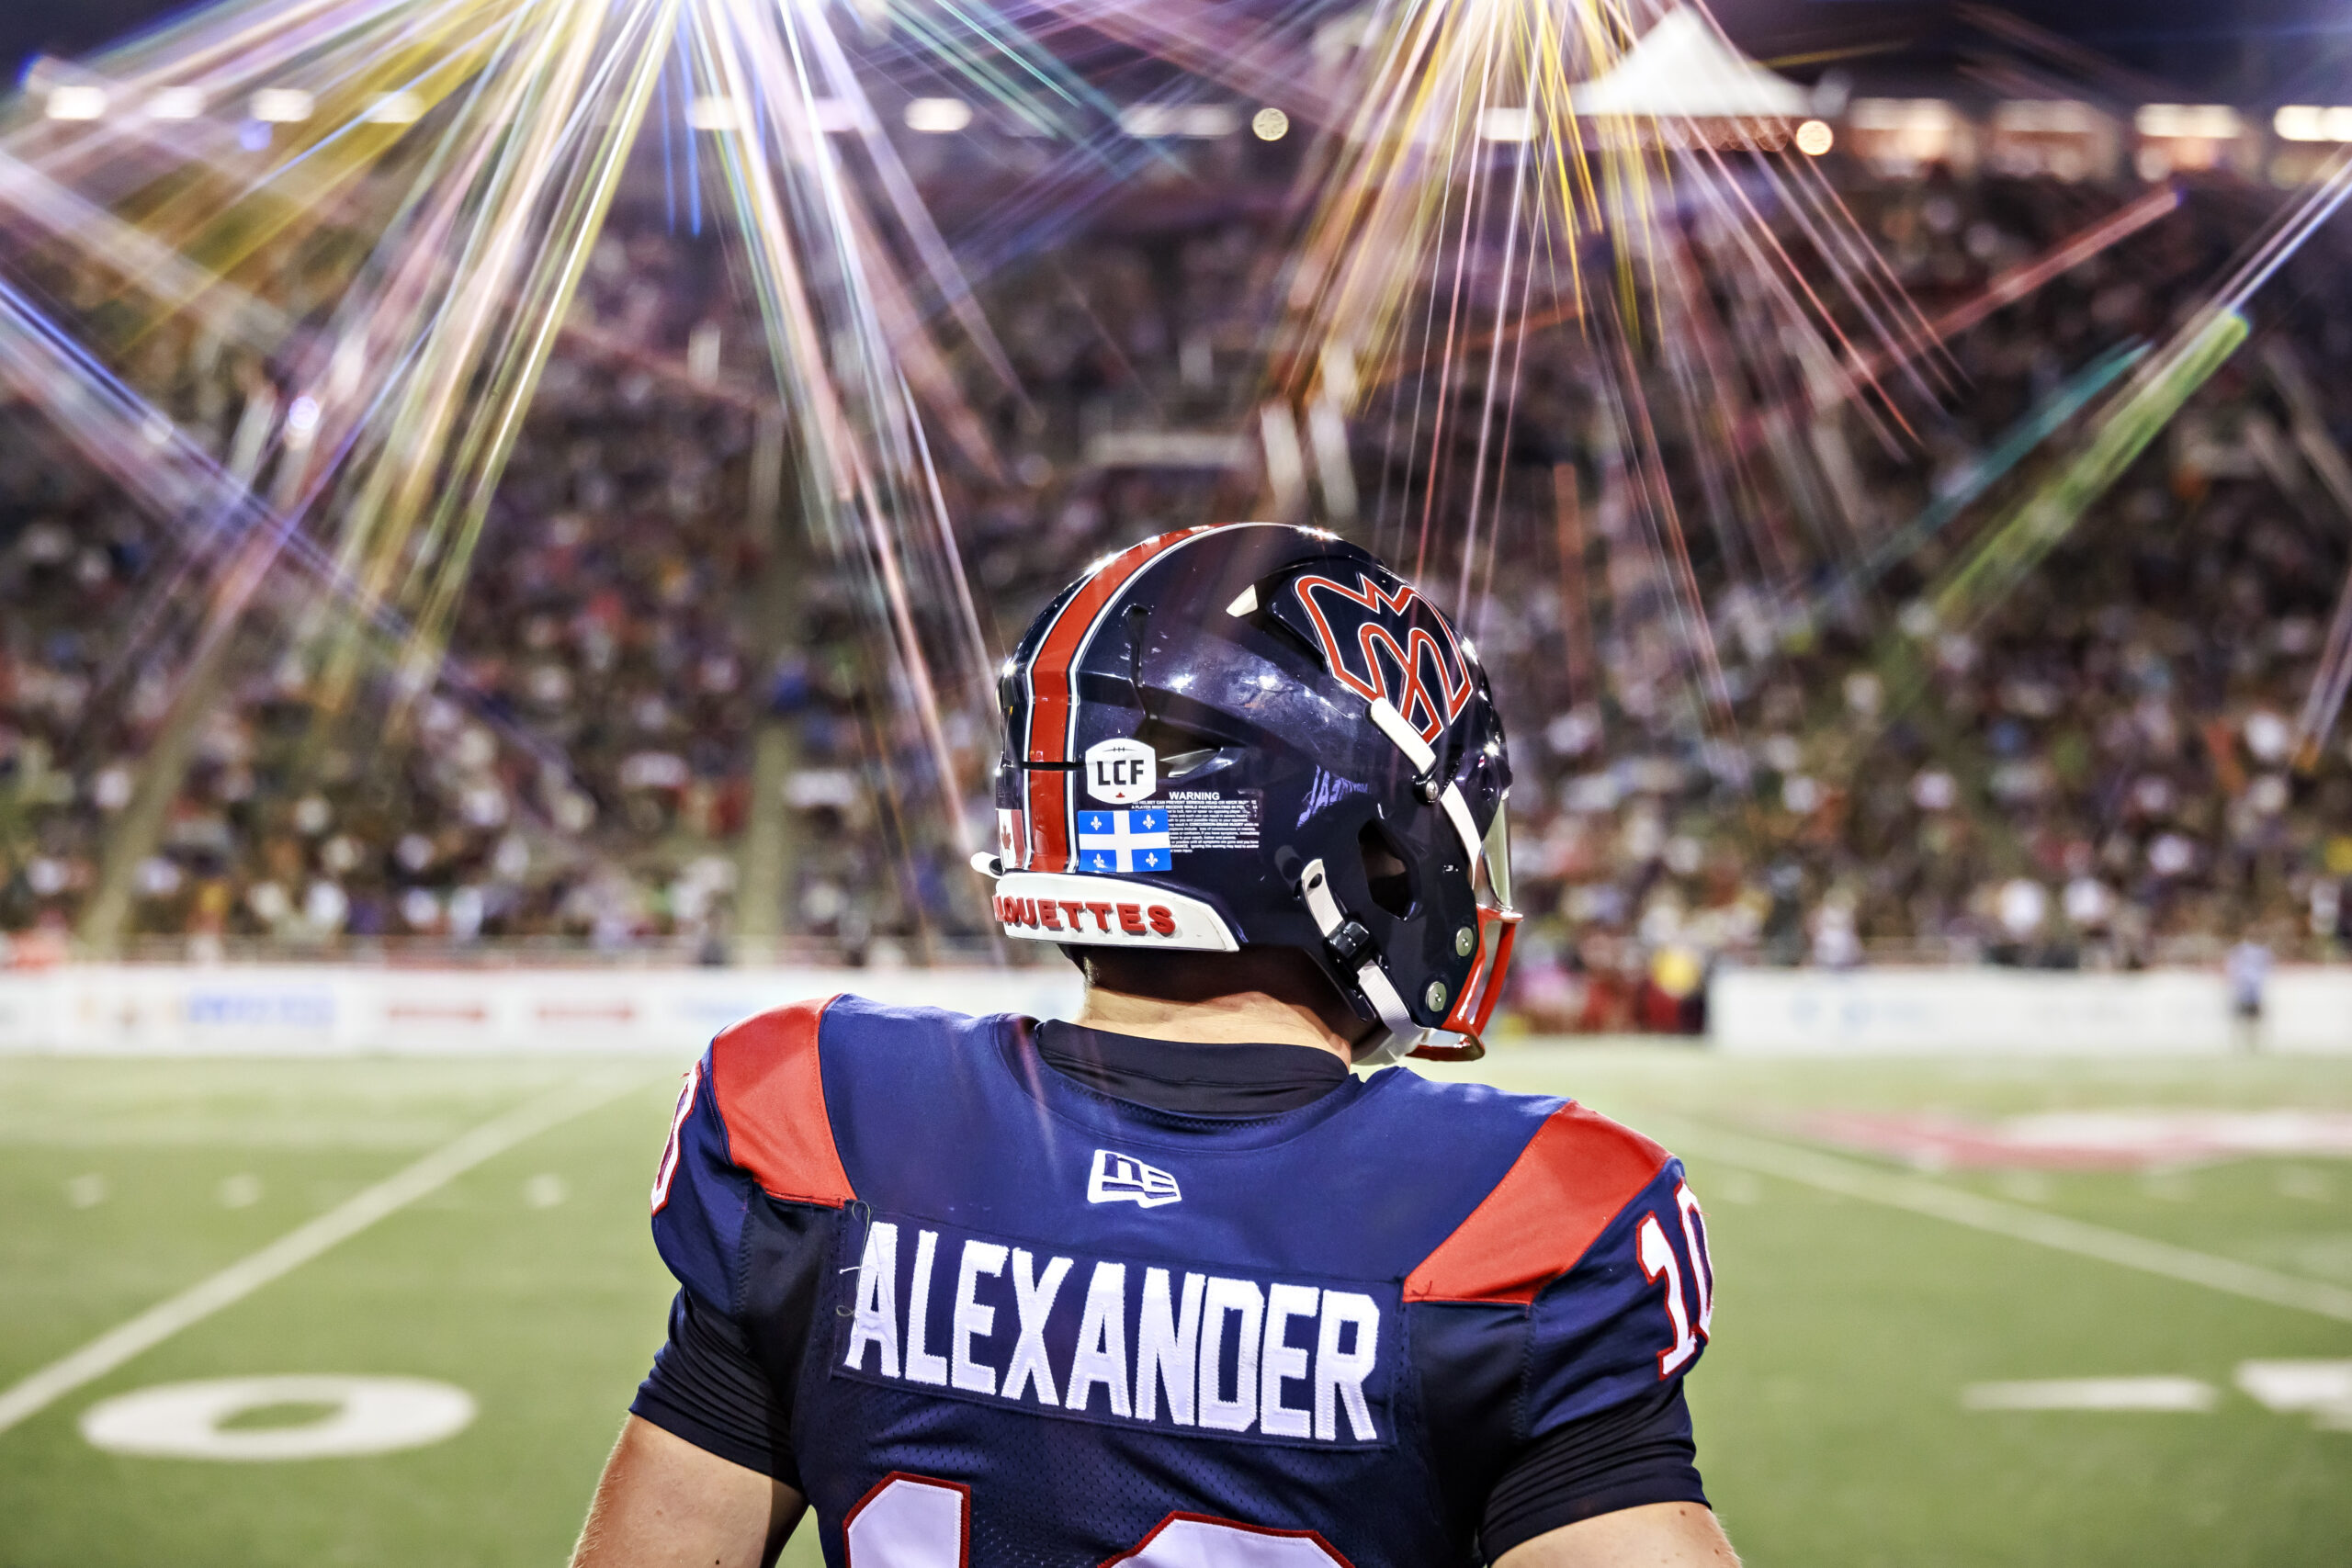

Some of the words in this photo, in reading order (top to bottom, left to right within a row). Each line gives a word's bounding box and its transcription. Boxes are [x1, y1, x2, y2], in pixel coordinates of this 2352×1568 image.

[1096, 760, 1144, 785] LCF
[1169, 791, 1220, 800] WARNING
[844, 1221, 1380, 1441] ALEXANDER
[1635, 1176, 1713, 1382] 10
